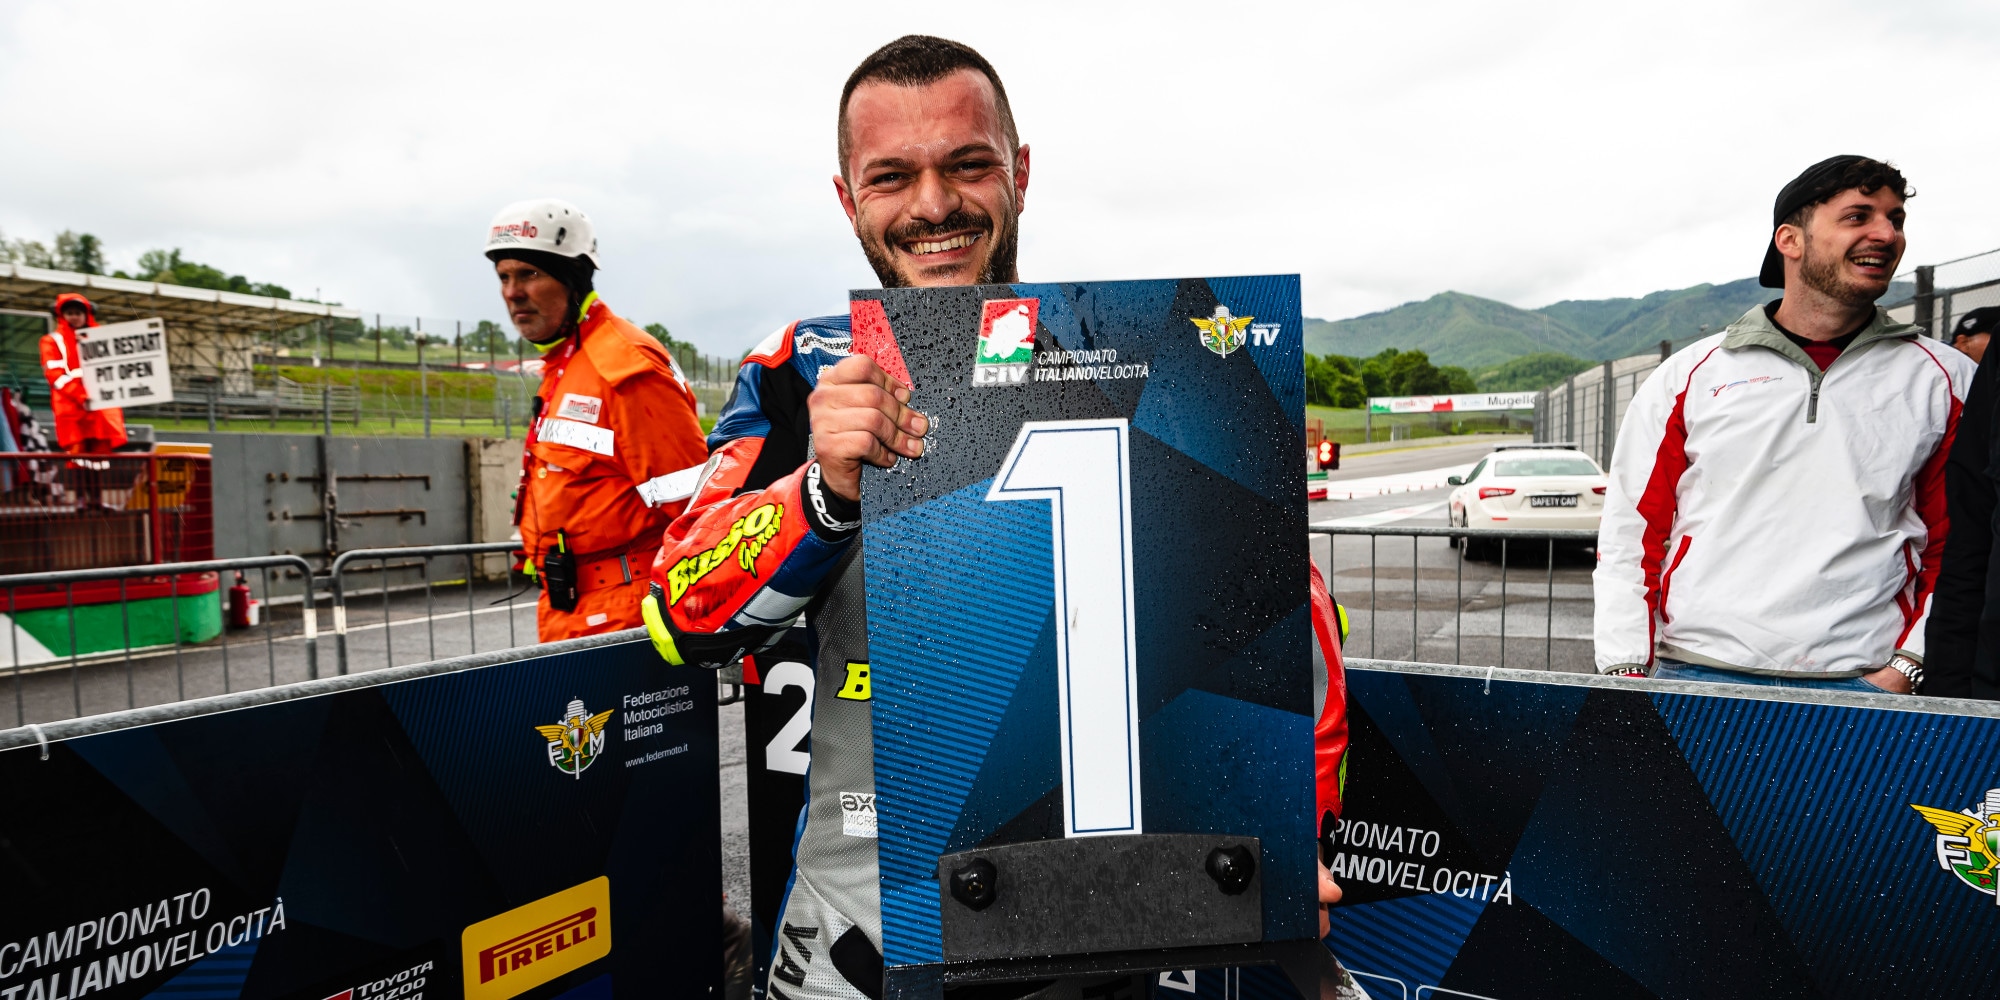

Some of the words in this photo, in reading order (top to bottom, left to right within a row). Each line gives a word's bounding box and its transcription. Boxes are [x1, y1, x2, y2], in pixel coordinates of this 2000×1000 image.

[113, 332, 161, 356] RESTART
[1251, 328, 1281, 347] TV
[1038, 349, 1117, 366] CAMPIONATO
[96, 366, 113, 383] PIT
[119, 361, 153, 380] OPEN
[1531, 496, 1559, 507] SAFETY
[1560, 496, 1577, 507] CAR
[985, 418, 1143, 838] 1
[623, 684, 690, 709] Federazione
[623, 698, 694, 726] Motociclistica
[763, 661, 815, 775] 2
[624, 722, 663, 742] Italiana
[625, 743, 689, 768] www.federmoto.it
[1329, 818, 1441, 858] PIONATO
[1329, 852, 1513, 906] ANOVELOCITÀ
[0, 887, 211, 979] CAMPIONATO
[479, 906, 597, 985] PIRELLI
[0, 897, 286, 1000] TALIANOVELOCITÀ
[357, 960, 434, 997] TOYOTA
